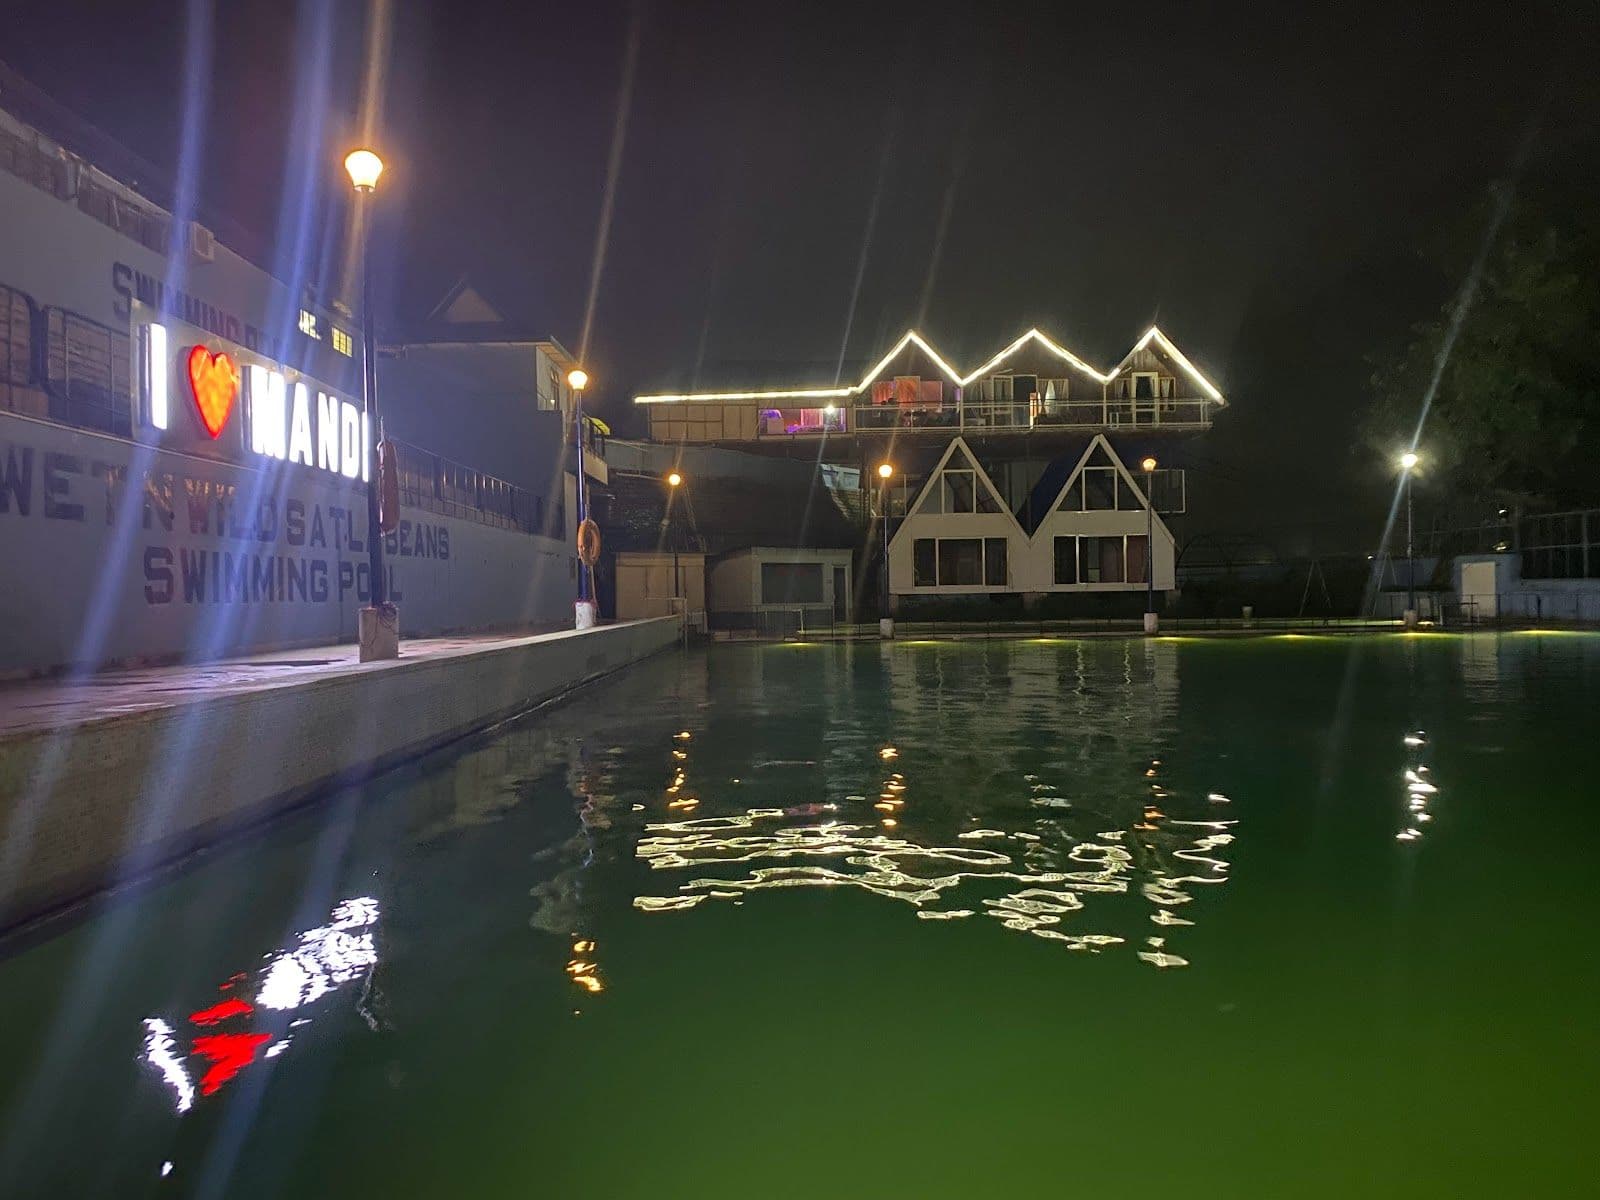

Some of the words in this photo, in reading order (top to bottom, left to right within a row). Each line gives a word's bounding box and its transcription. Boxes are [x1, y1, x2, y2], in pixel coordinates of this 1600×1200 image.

[148, 322, 168, 430] I
[248, 364, 370, 483] MANDI
[144, 546, 329, 605] SWIMMING
[339, 560, 403, 604] POL
